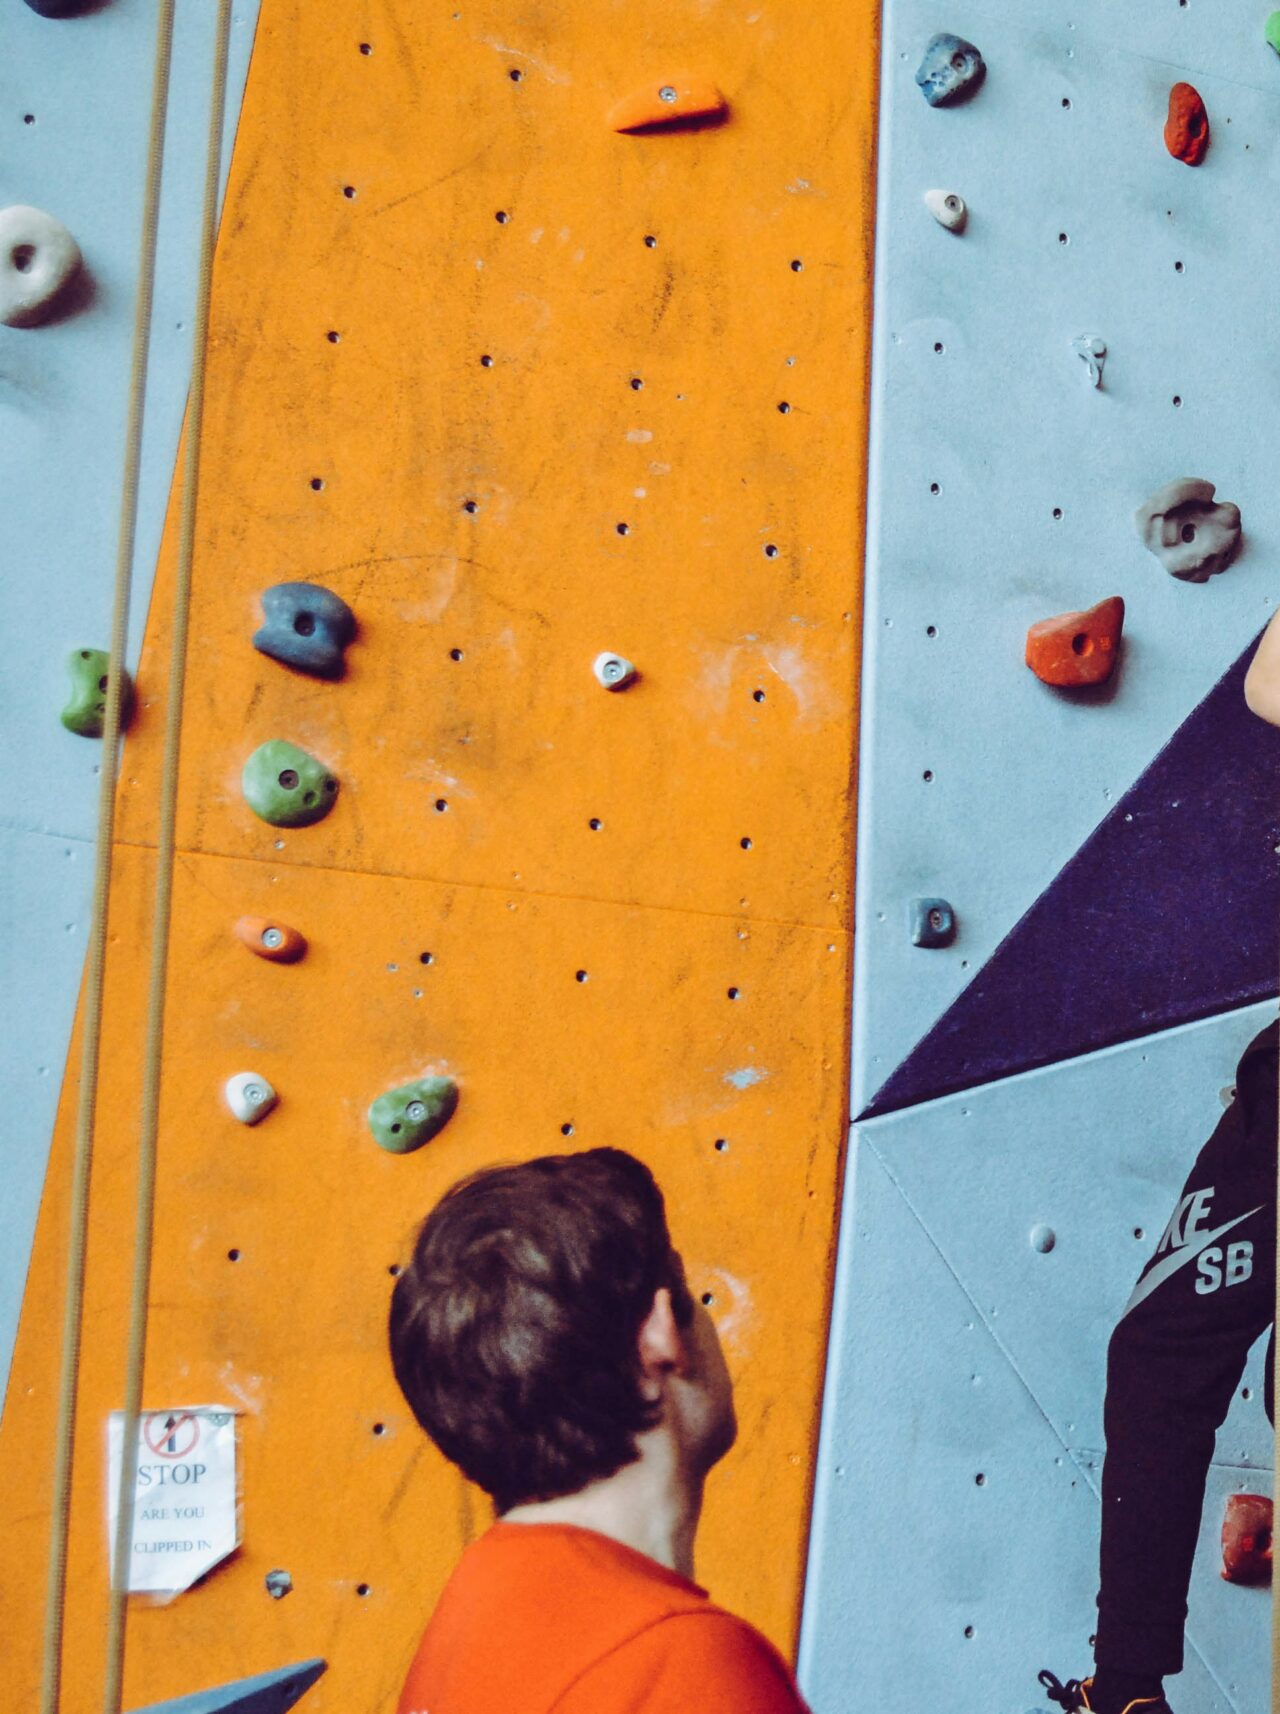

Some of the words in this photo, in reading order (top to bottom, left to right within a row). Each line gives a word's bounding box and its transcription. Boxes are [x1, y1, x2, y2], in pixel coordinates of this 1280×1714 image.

[1158, 1186, 1215, 1254] KE
[1195, 1240, 1254, 1295] SB
[138, 1463, 207, 1486] STOP
[140, 1508, 170, 1521] ARE
[174, 1506, 206, 1520] YOU
[134, 1540, 193, 1554] CLIPPED
[197, 1539, 213, 1551] IN
